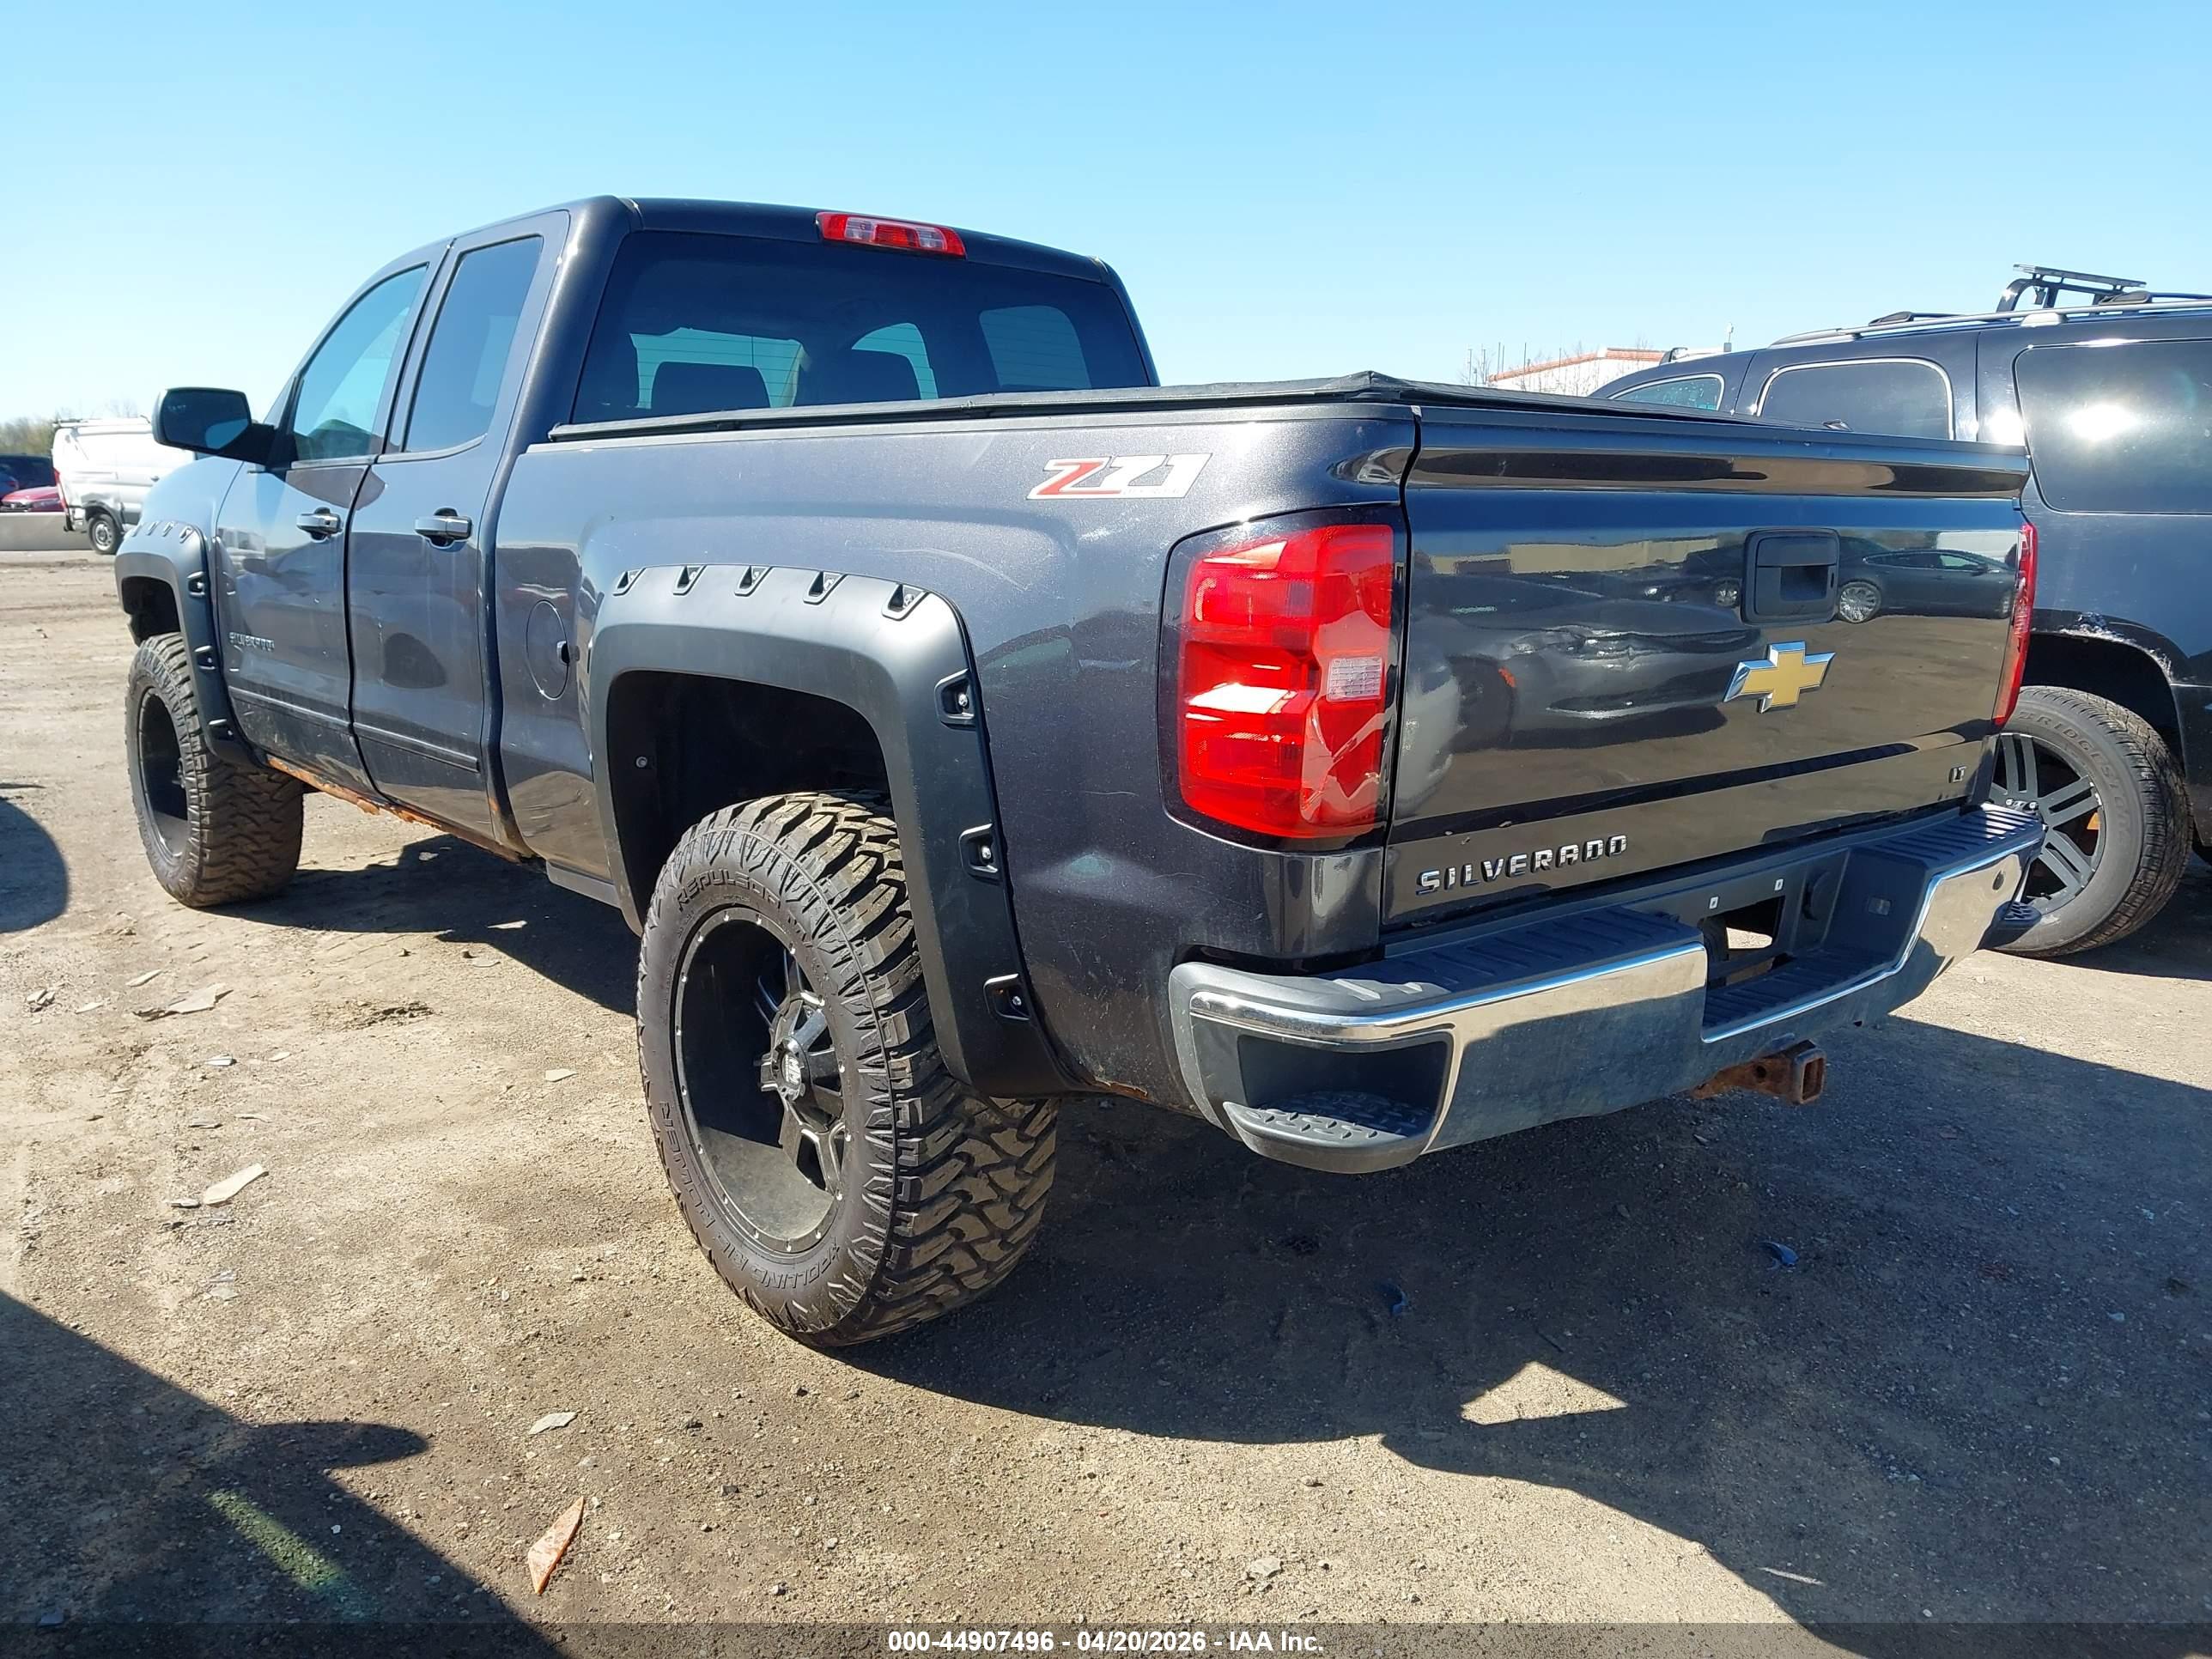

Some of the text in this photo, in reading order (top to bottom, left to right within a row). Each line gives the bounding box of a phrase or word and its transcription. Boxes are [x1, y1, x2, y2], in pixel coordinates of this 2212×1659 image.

[1026, 453, 1213, 500] Z71
[1948, 766, 1966, 783] LT
[1418, 834, 1628, 895] SILVERADO
[658, 1100, 715, 1235] POWER
